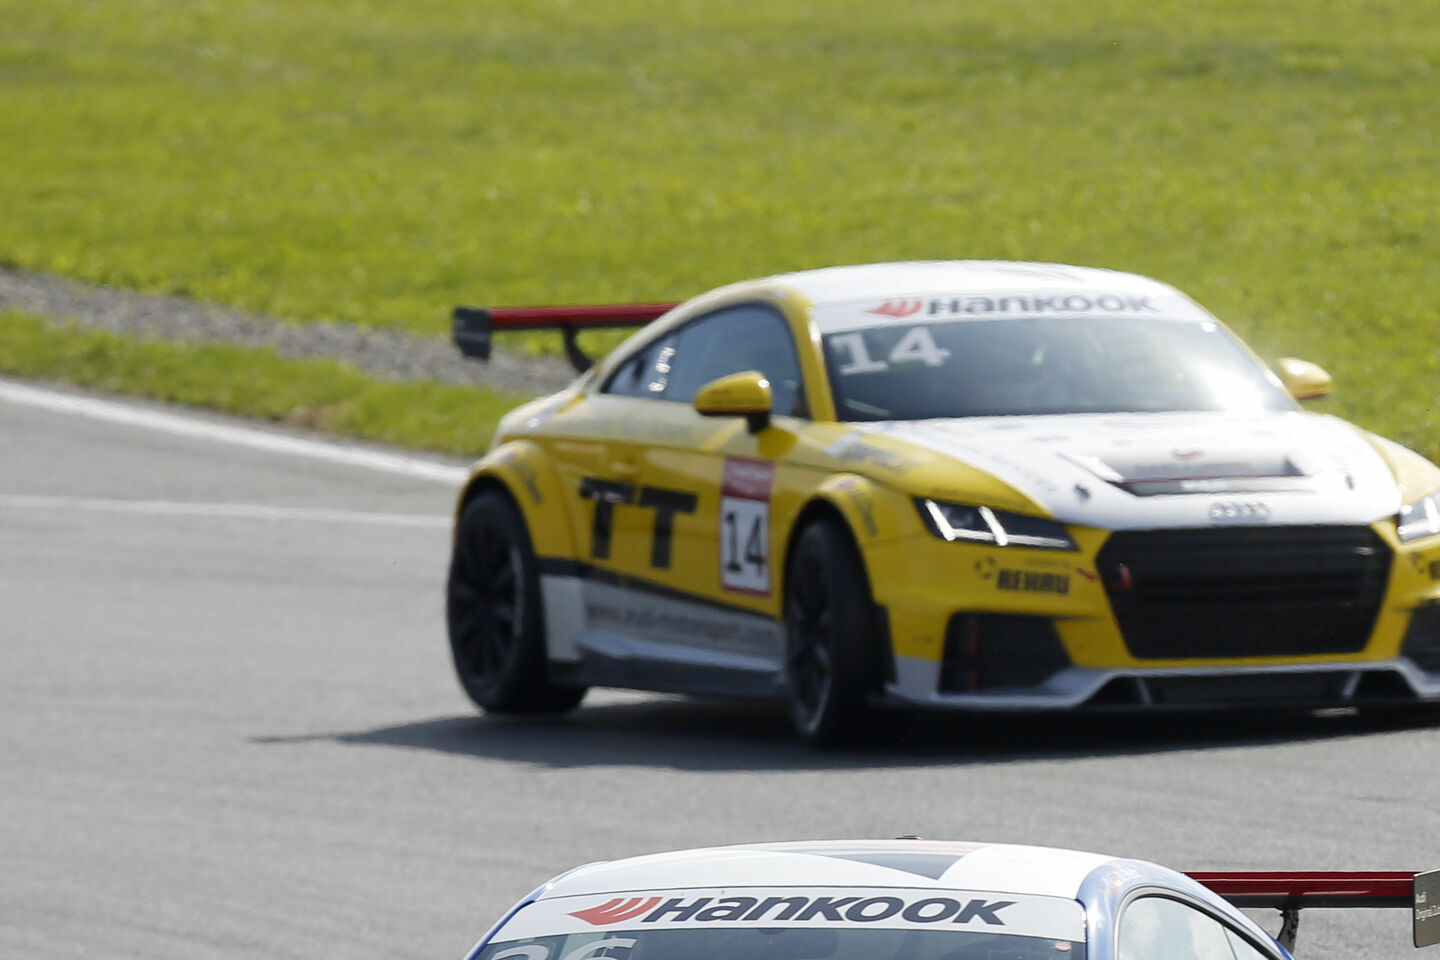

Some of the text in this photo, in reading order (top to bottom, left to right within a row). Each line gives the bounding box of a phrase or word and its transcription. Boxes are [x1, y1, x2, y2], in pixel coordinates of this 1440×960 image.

[831, 327, 951, 376] 14
[580, 475, 698, 571] TT
[726, 512, 765, 576] 14
